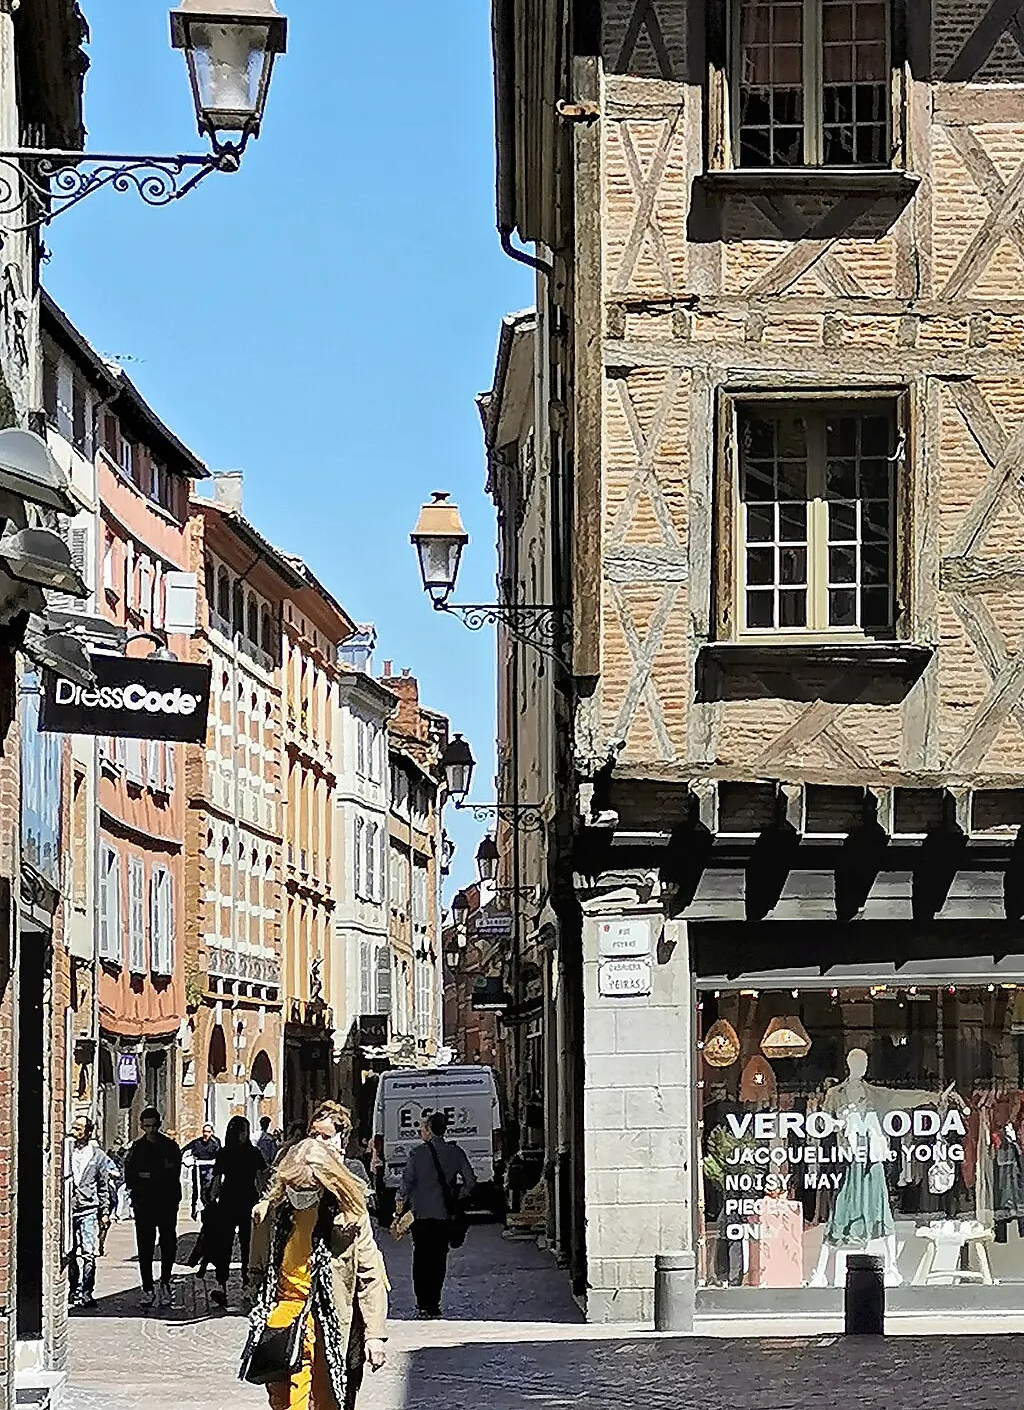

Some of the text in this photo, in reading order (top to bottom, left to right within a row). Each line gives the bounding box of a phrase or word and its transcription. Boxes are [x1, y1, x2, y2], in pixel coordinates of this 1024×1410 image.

[55, 678, 199, 715] DressCode
[726, 1109, 966, 1139] VERO MODA
[726, 1144, 868, 1166] JACQUELINE
[902, 1144, 965, 1161] YONG
[725, 1172, 843, 1191] NOISY MAY
[726, 1198, 787, 1216] PIEC
